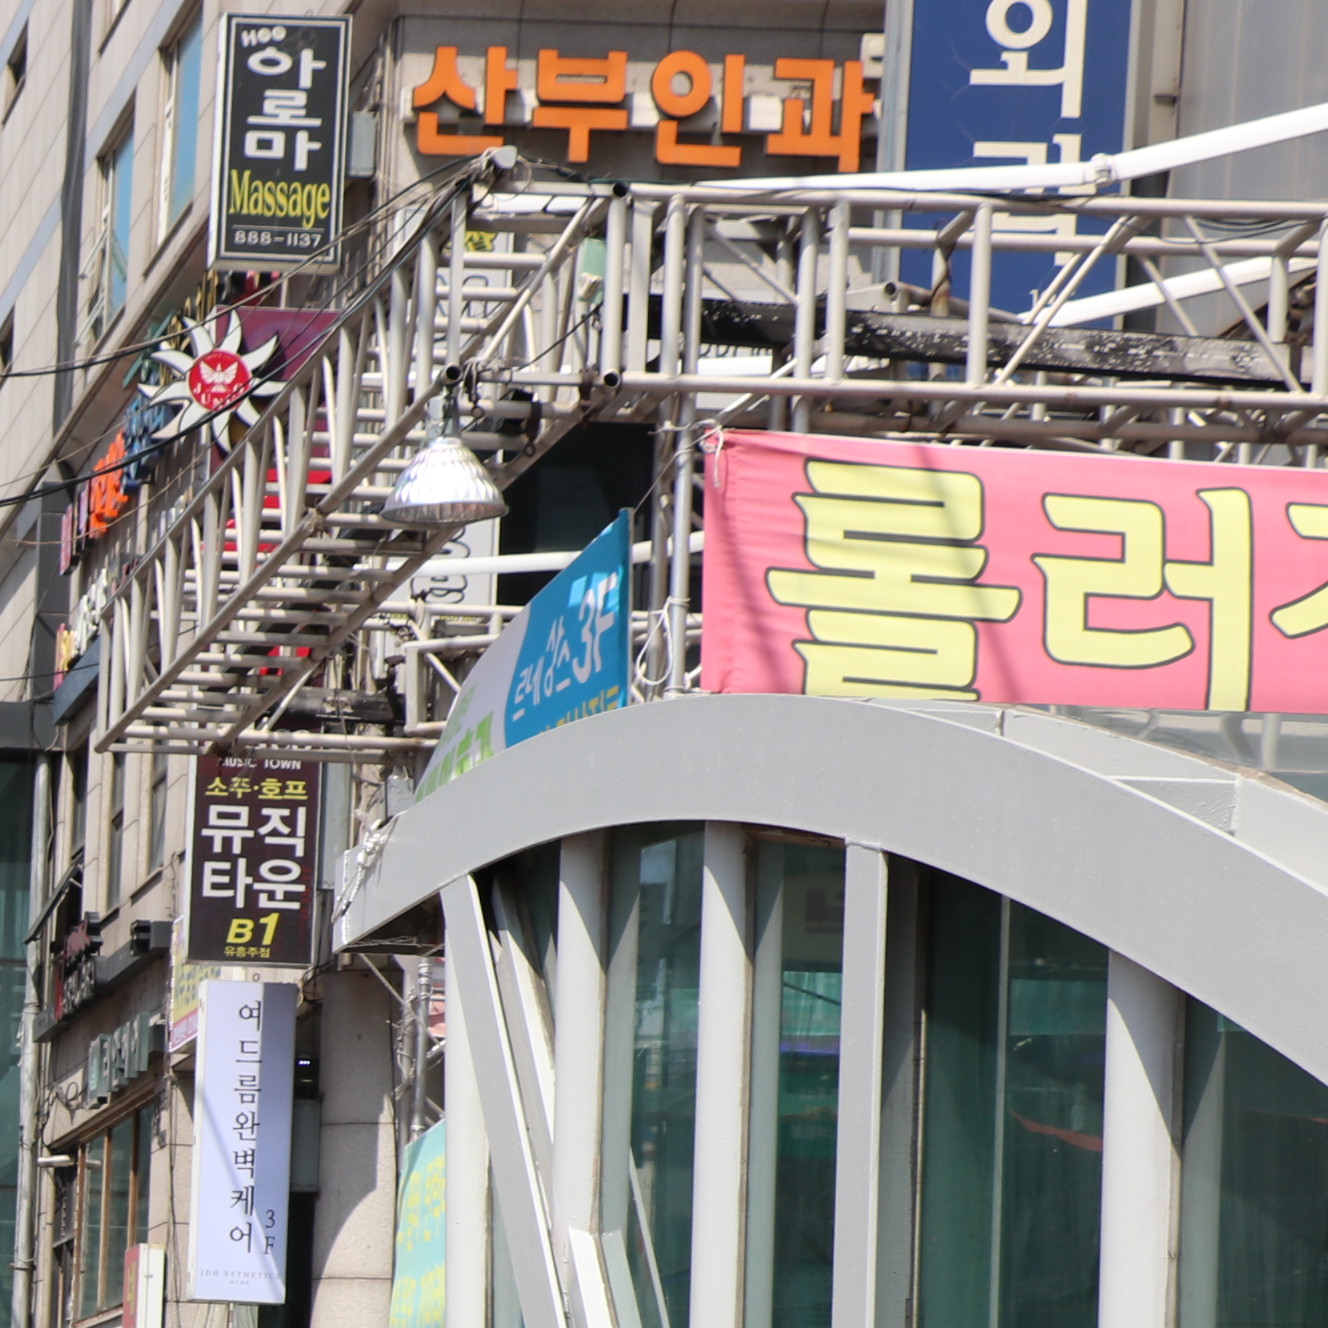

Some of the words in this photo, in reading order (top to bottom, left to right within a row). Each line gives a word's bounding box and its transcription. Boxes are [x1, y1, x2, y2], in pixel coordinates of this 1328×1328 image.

[245, 46, 328, 172] 아로마
[413, 45, 876, 173] 산부인과
[229, 168, 331, 230] Massage
[234, 230, 323, 249] 888-1137
[572, 571, 620, 685] 3F
[201, 804, 307, 858] 뮤직
[201, 857, 307, 910] 타운
[226, 912, 280, 946] B1
[229, 999, 263, 1254] 여드름완벽케어
